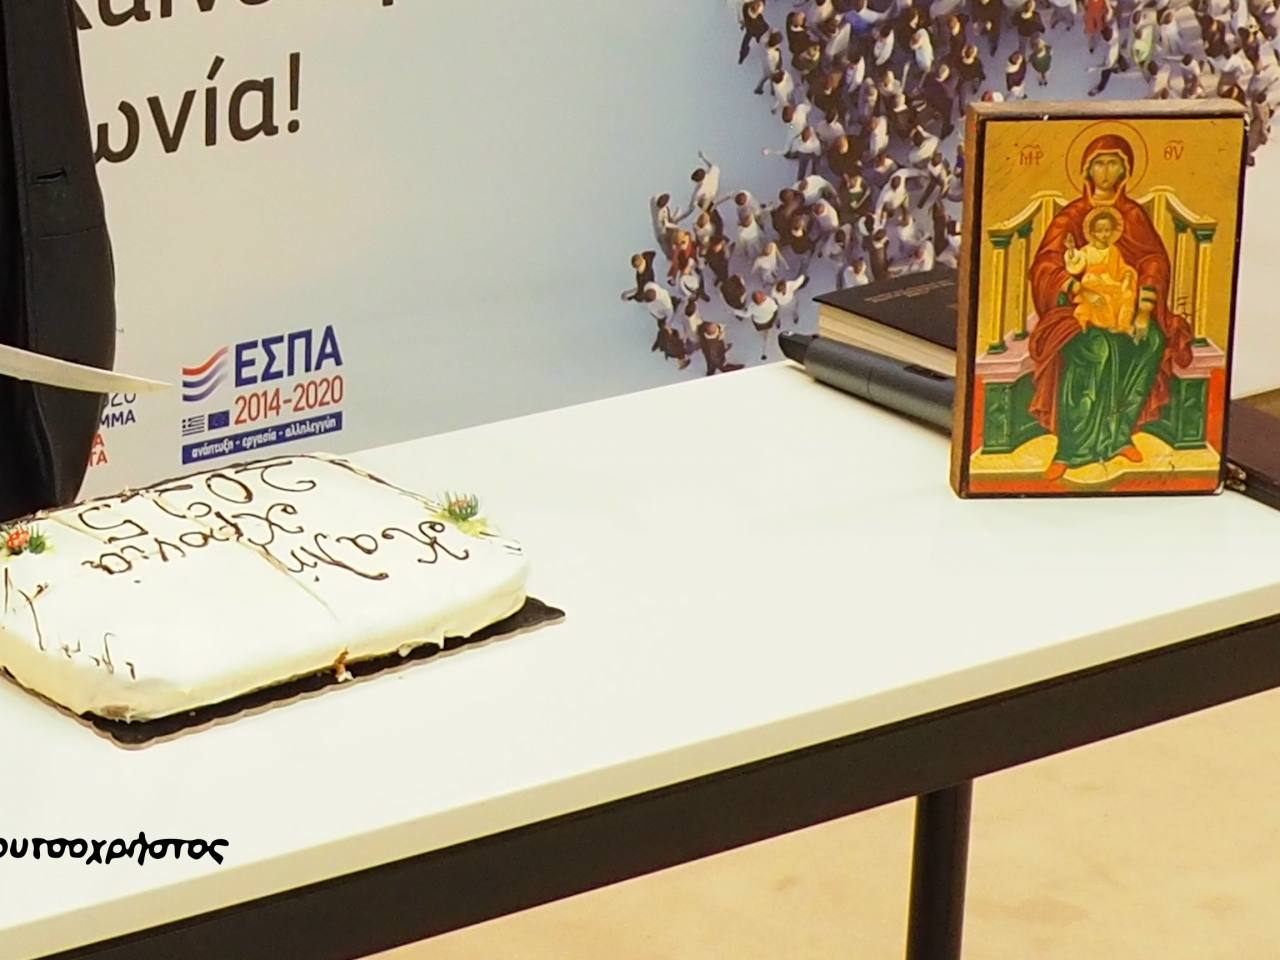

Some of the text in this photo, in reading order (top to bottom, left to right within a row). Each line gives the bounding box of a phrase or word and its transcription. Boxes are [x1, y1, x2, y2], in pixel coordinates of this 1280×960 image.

[235, 325, 343, 388] ΕΣΠΑ
[234, 375, 344, 425] 2014-2020
[191, 439, 234, 458] ανάπτυξη
[242, 428, 278, 448] εργασία
[285, 416, 337, 438] αλληλεγγύη
